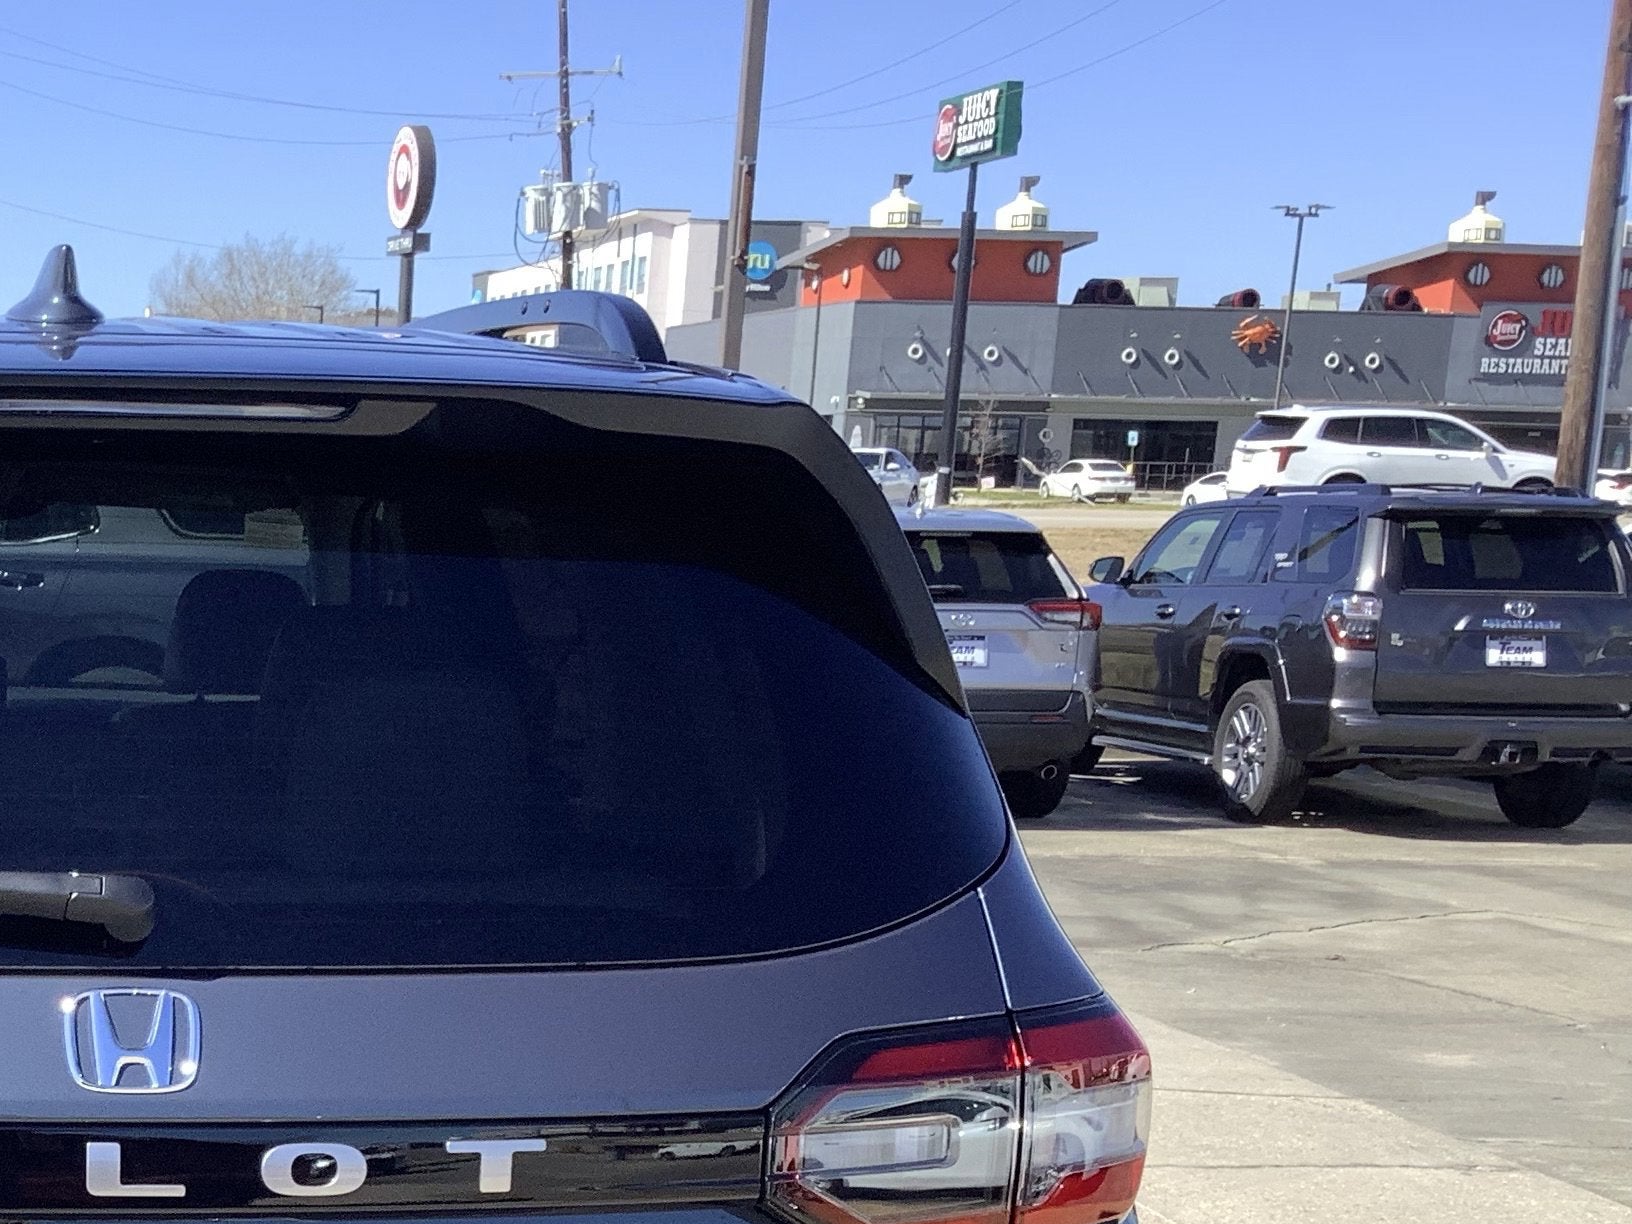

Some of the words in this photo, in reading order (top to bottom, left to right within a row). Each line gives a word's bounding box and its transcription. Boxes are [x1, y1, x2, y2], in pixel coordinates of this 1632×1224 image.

[959, 88, 1000, 124] JUICY
[957, 117, 996, 143] SEAFOOD
[1480, 357, 1568, 375] RESTAURANT
[1499, 641, 1533, 655] TEAM
